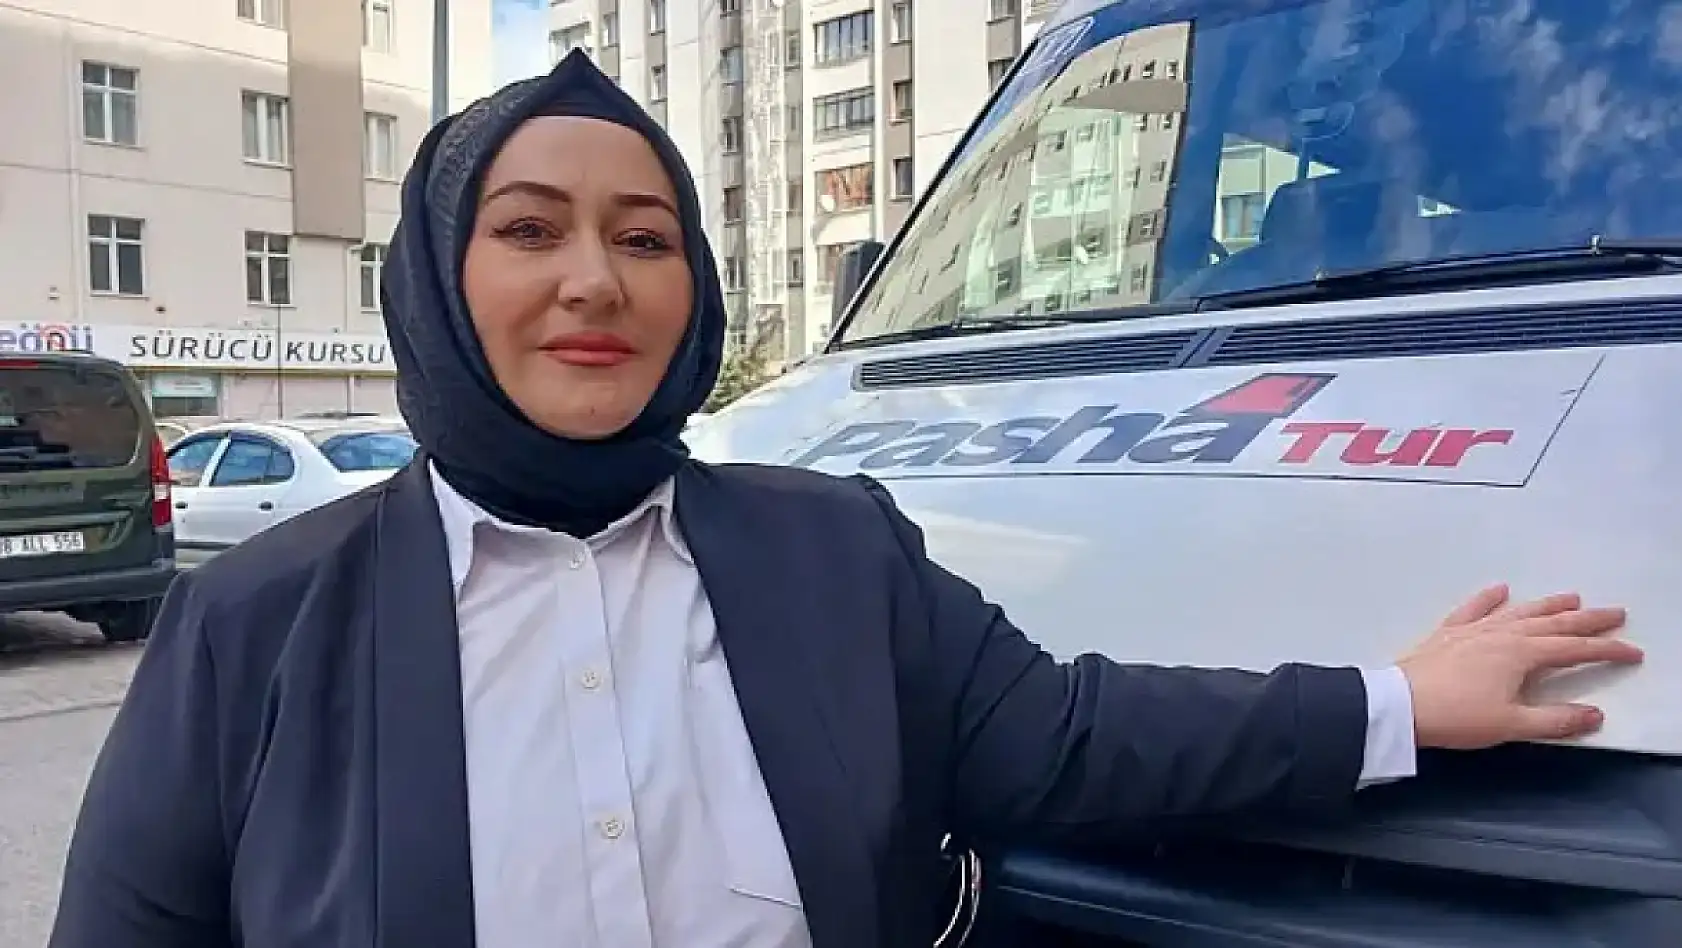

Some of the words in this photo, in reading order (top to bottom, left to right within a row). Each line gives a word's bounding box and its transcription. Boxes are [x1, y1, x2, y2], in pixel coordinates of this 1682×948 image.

[130, 329, 273, 361] SÜRÜCÜ
[286, 341, 386, 365] KURSU
[788, 400, 1280, 468] Pasha
[1278, 422, 1514, 467] Tur
